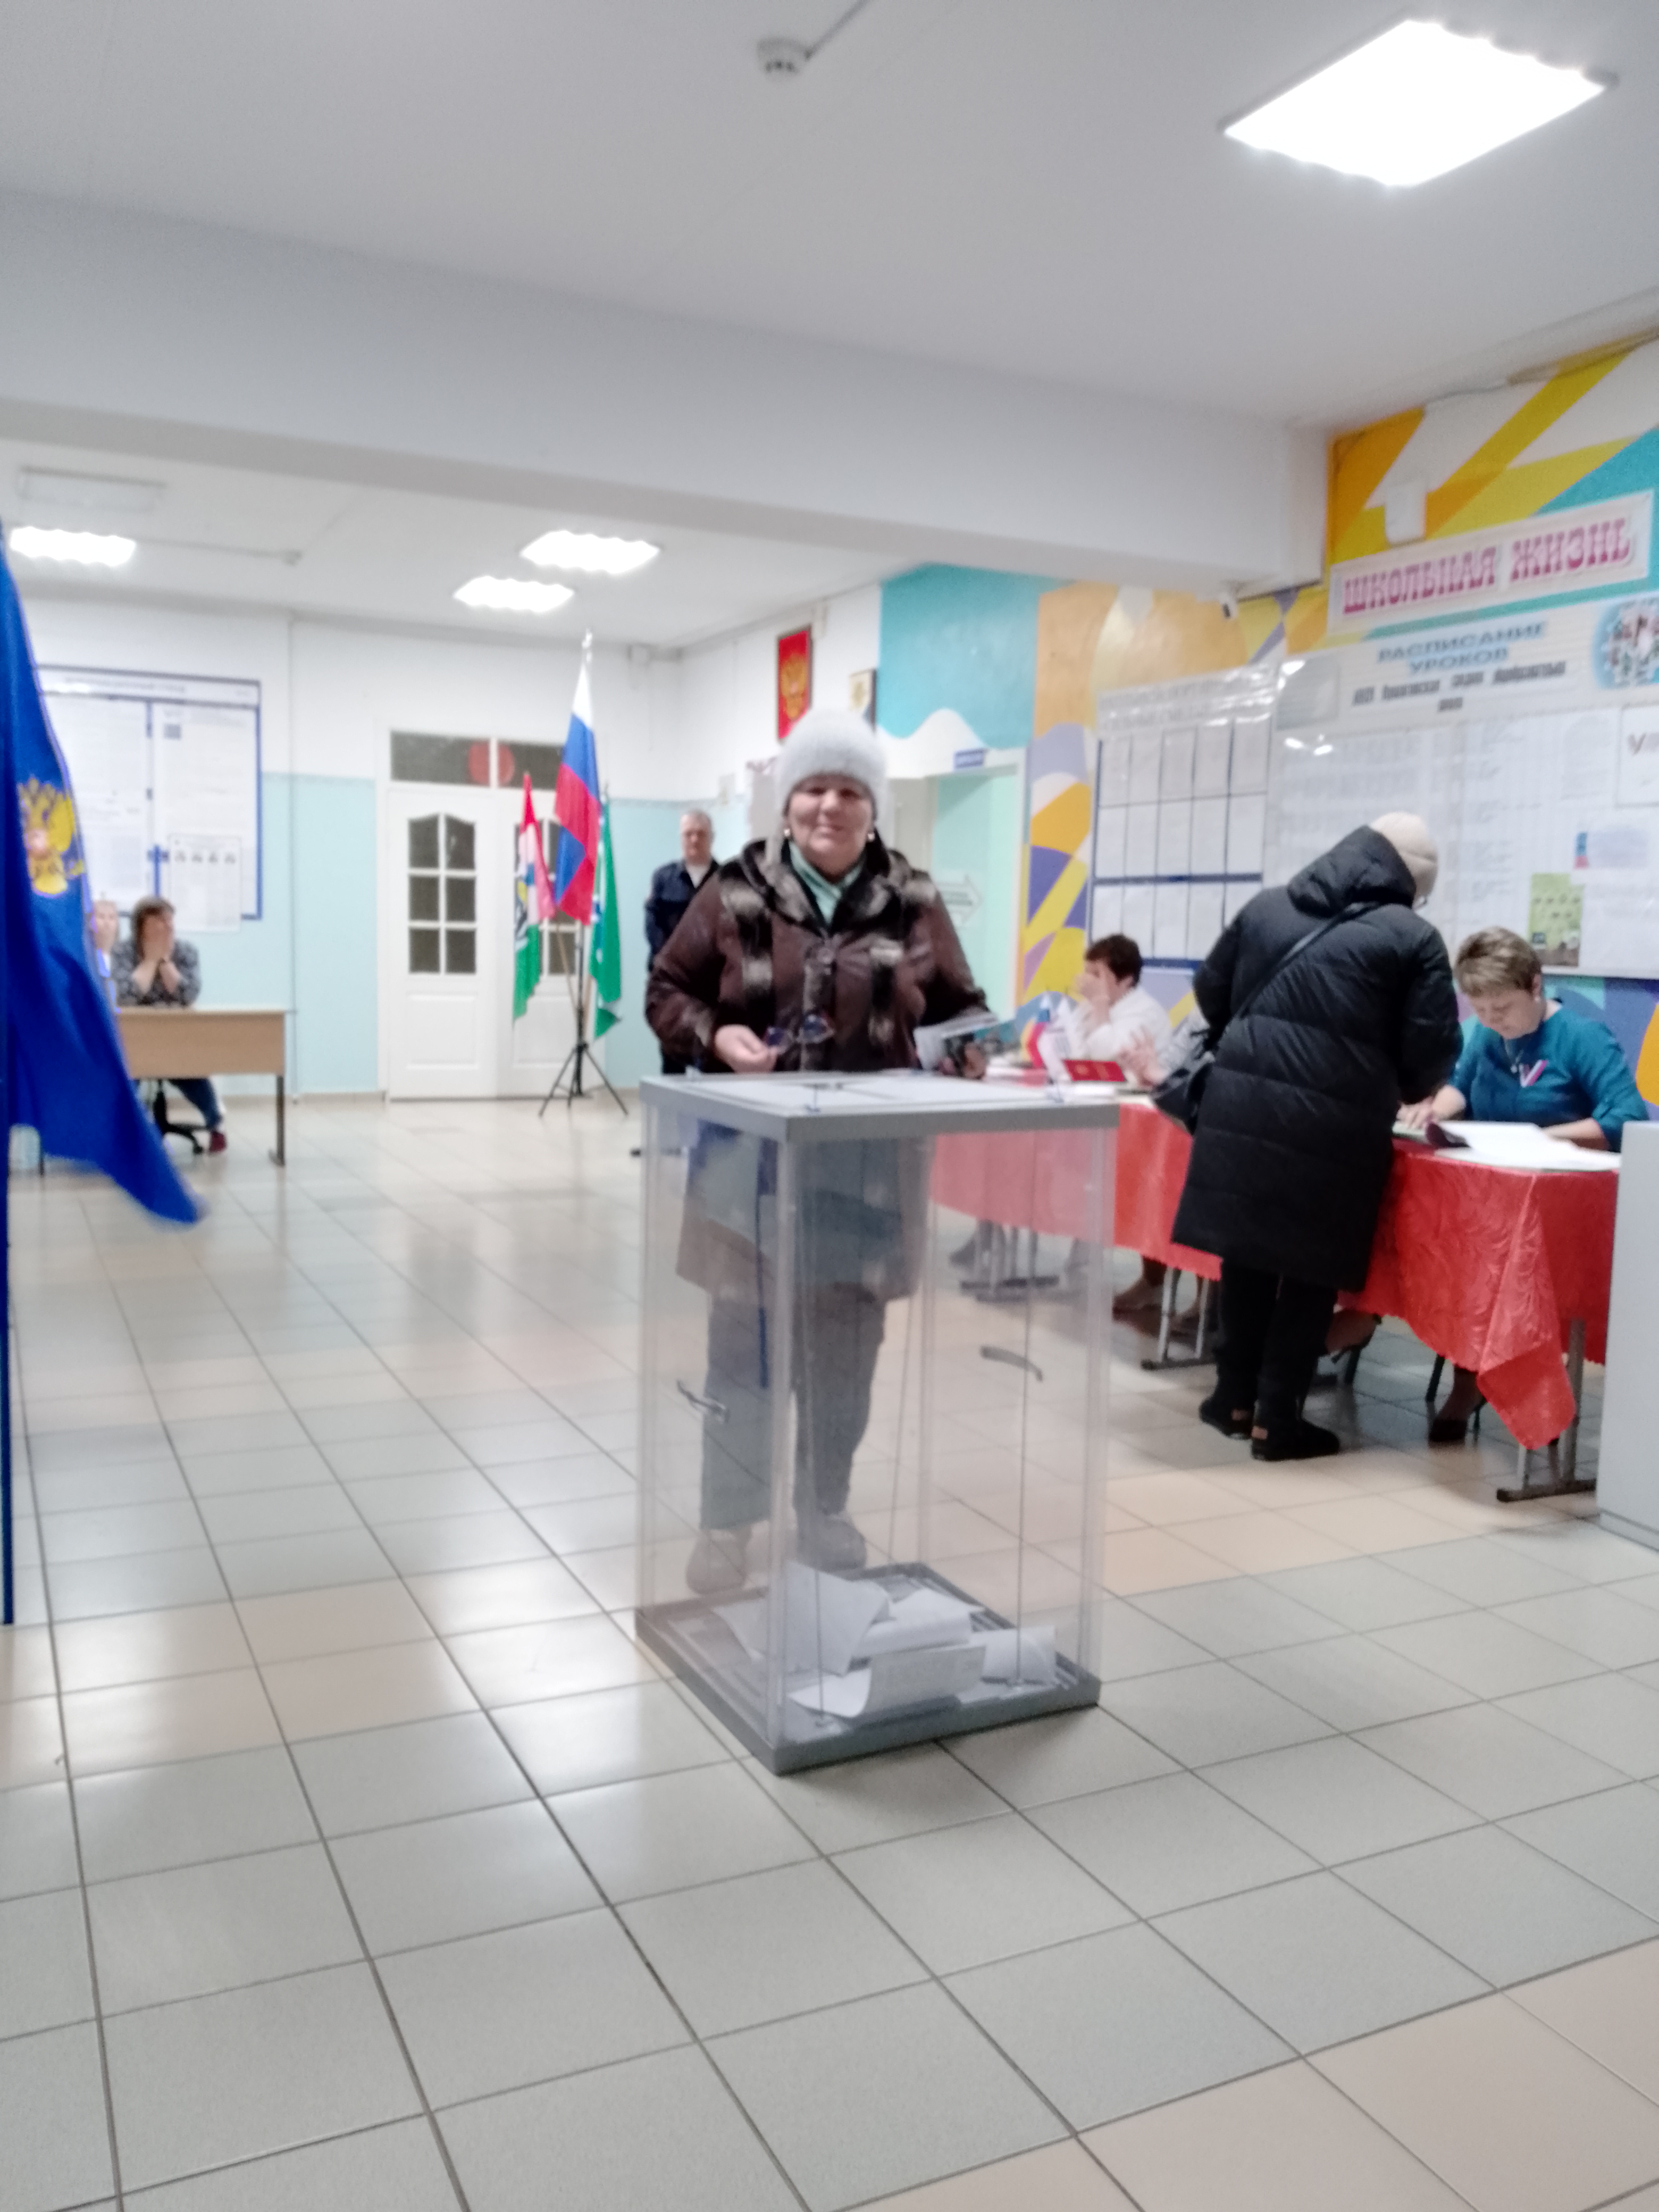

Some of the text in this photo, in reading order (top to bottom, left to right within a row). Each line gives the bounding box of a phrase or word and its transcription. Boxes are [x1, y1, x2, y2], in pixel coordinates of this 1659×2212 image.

[1343, 517, 1631, 614] ШКОЛЬНАЯ ЖИЗНЬ
[1378, 623, 1544, 662] РАСПИСАНИЕ
[1410, 647, 1508, 674] УРОКОВ
